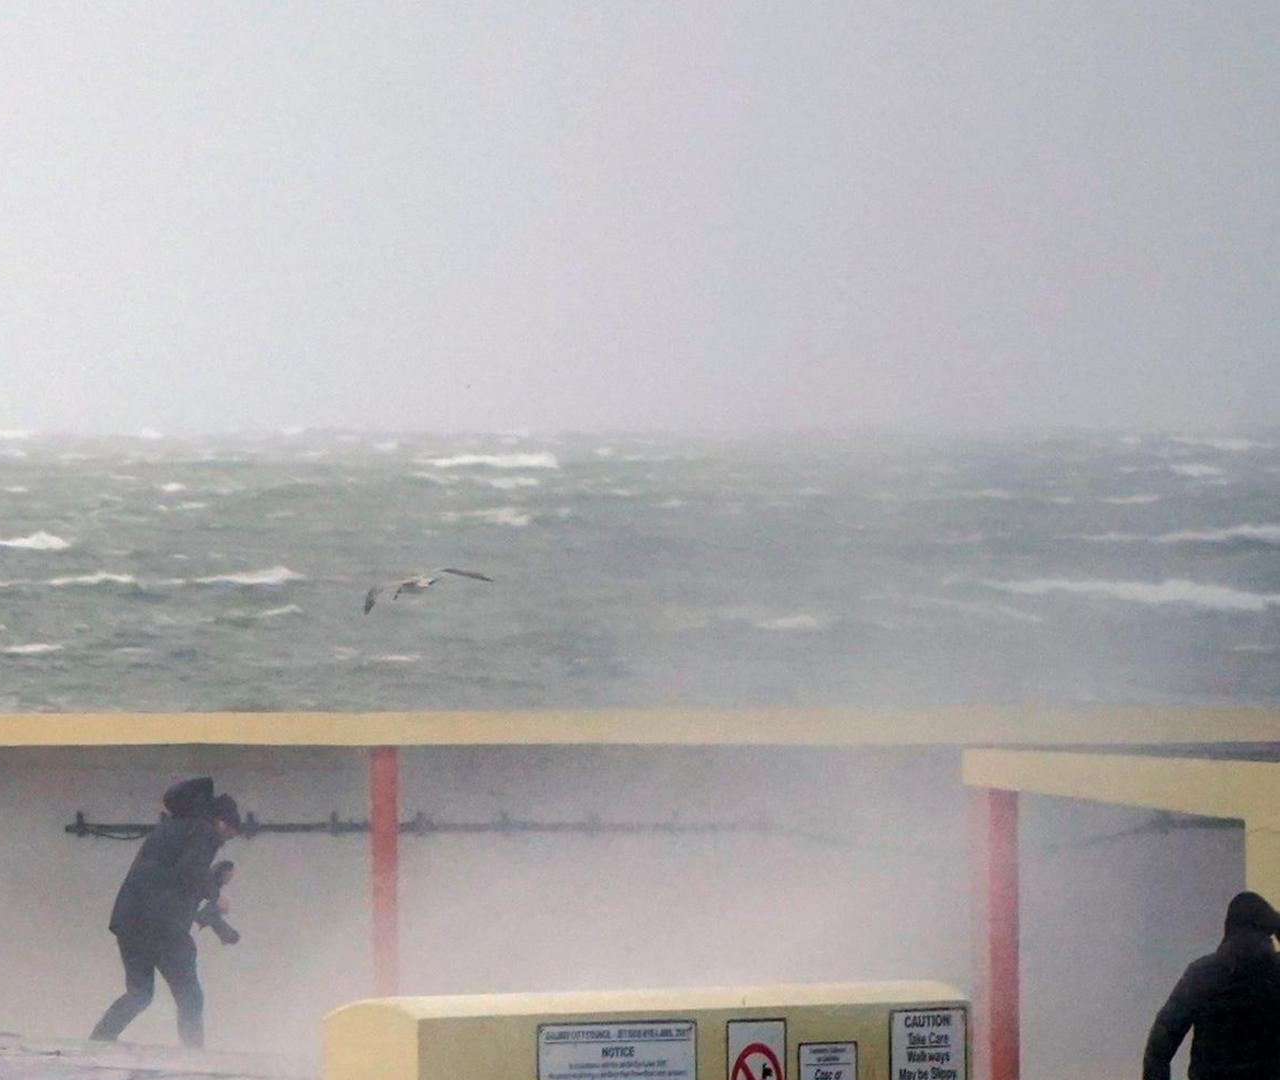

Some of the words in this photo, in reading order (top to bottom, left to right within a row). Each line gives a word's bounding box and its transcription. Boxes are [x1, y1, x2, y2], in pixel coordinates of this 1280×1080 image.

[908, 1031, 926, 1044] Take
[928, 1031, 950, 1044] Care
[601, 1046, 635, 1057] NOTICE
[917, 1067, 929, 1080] be
